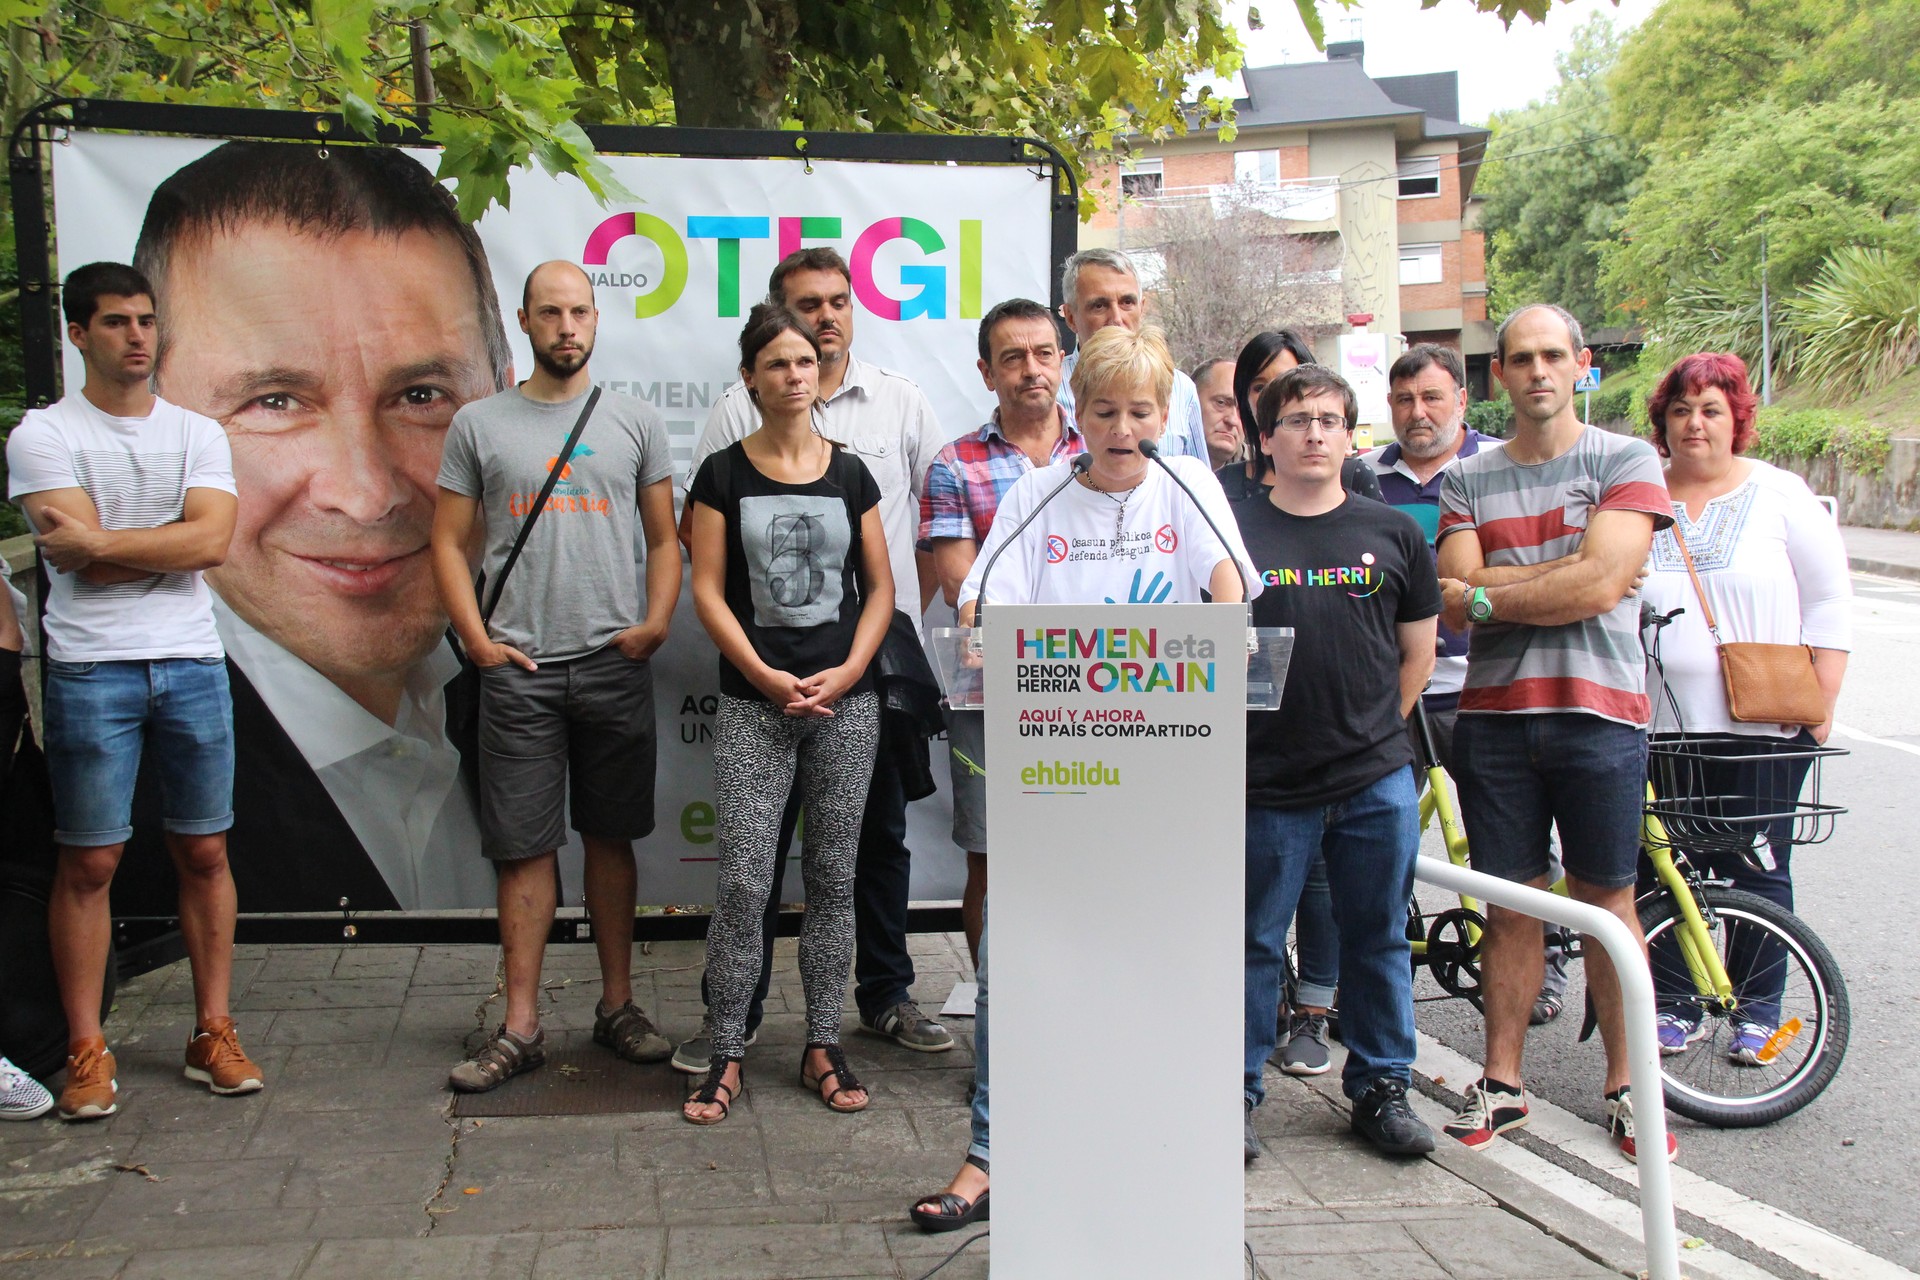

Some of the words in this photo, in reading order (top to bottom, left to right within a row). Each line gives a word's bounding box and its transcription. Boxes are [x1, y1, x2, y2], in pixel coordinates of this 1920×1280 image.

[1072, 537, 1106, 548] Osasun
[1068, 550, 1108, 562] defenda
[1257, 568, 1302, 587] GIN
[1308, 566, 1371, 587] HERRI
[1016, 628, 1157, 659] HEMEN
[1163, 634, 1215, 659] eta
[1017, 664, 1081, 678] DENON
[1086, 661, 1215, 693] ORAIN
[1017, 679, 1081, 693] HERRIA
[1018, 707, 1062, 723] AQUÍ
[1066, 709, 1078, 723] Y
[1083, 709, 1146, 723] AHORA
[1019, 724, 1044, 737] UN
[1049, 721, 1087, 737] PAÍS
[1091, 724, 1212, 738] COMPARTIDO
[1020, 760, 1121, 786] ehbildu
[1822, 994, 1836, 1052] KENDA
